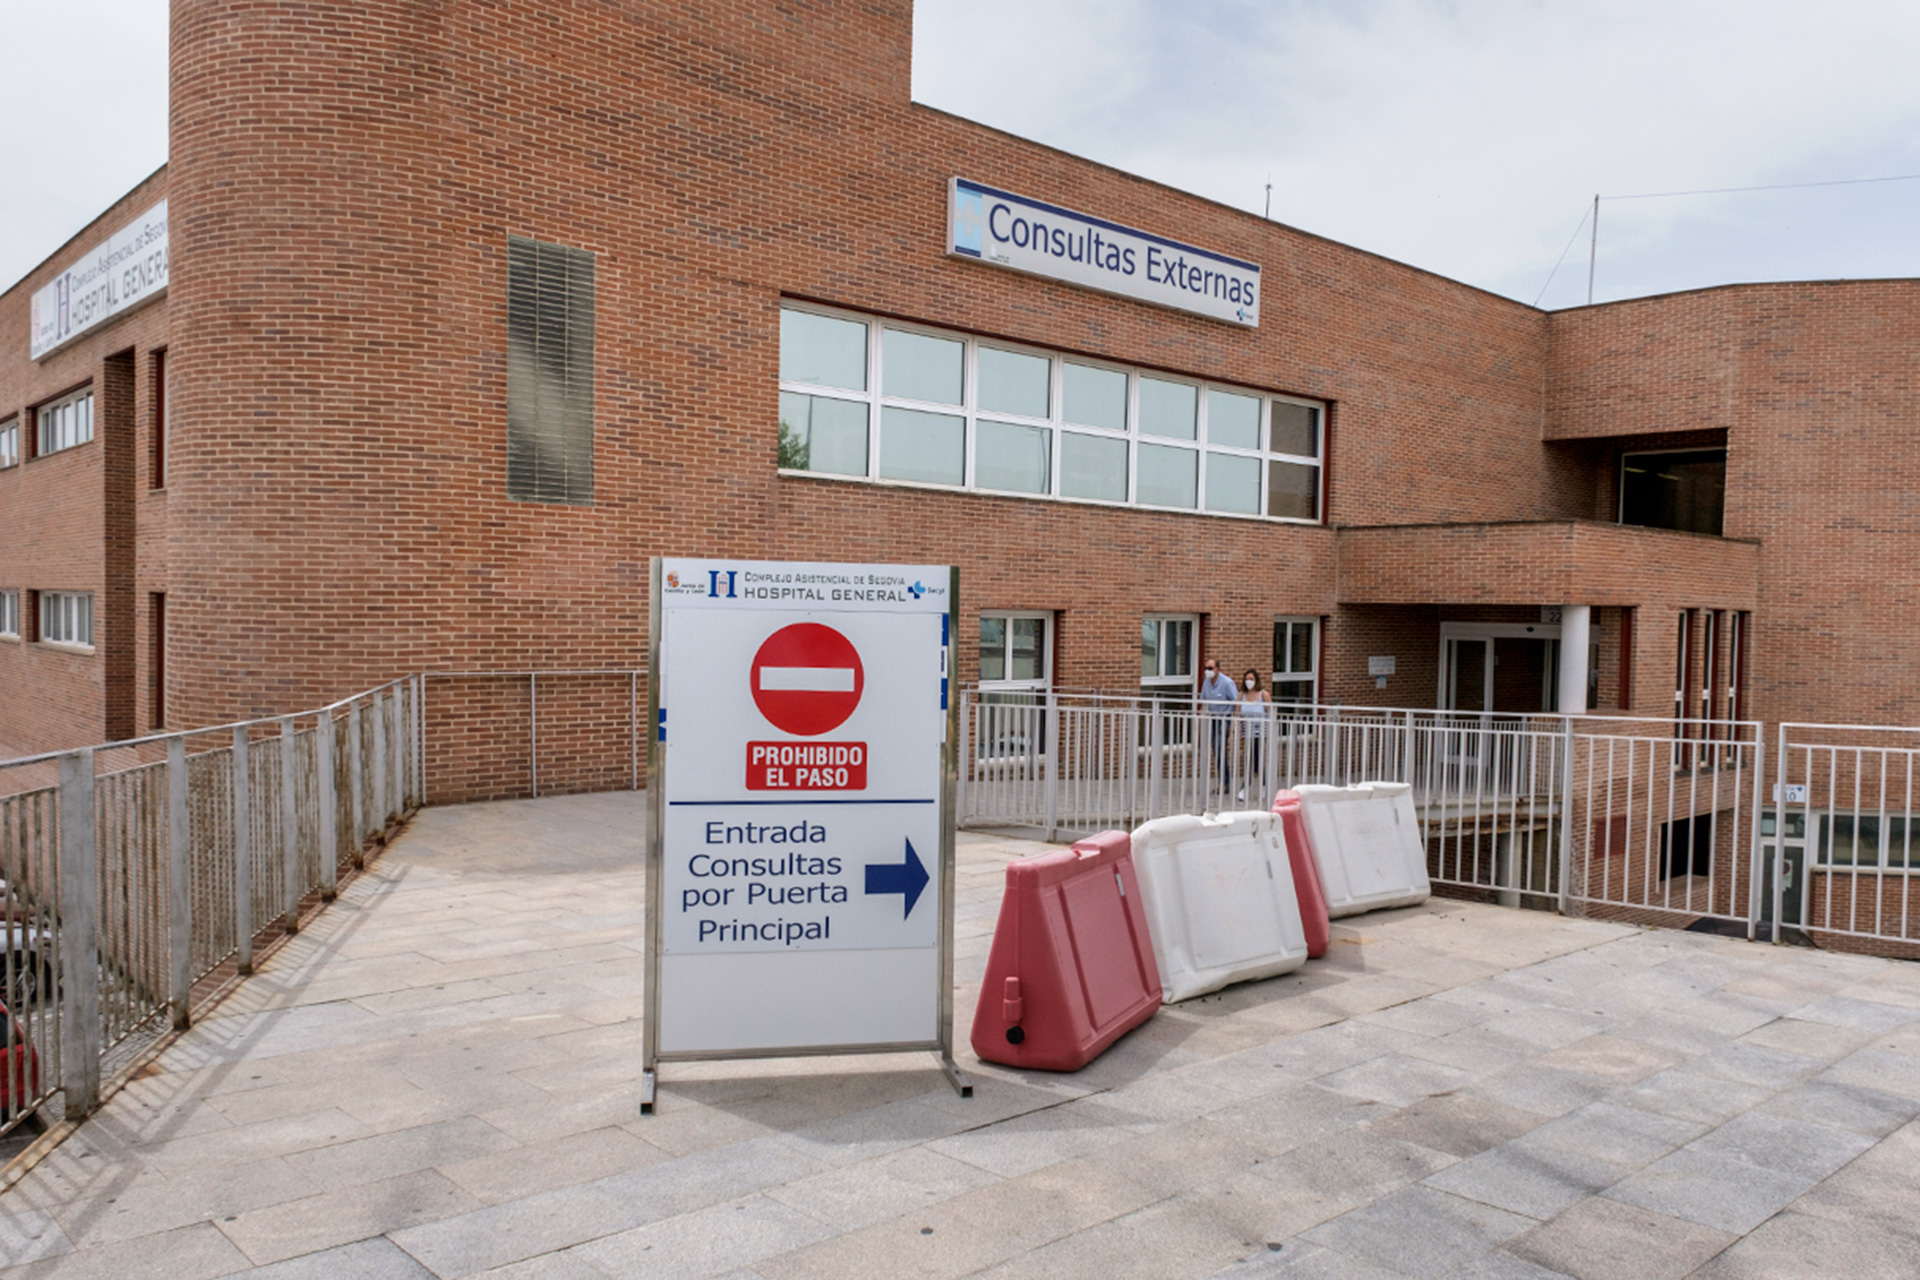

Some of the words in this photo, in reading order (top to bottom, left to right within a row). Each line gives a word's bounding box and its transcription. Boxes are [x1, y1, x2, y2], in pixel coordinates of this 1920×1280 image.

[988, 203, 1136, 277] Consultas
[1146, 245, 1255, 308] Externas
[72, 278, 119, 329] HOSPITAL
[744, 571, 792, 583] COMPLEJO
[795, 573, 851, 585] ASISTENCIAL
[853, 575, 866, 585] DE
[868, 574, 906, 586] SEGOVIA
[744, 587, 825, 601] HOSPITAL
[831, 588, 907, 602] GENERAL
[752, 746, 863, 766] PROHIBIDO
[766, 767, 790, 787] EL
[796, 767, 849, 787] PASO
[706, 820, 827, 845] Entrada
[688, 852, 843, 878] Consultas
[682, 888, 736, 913] por
[748, 882, 849, 906] Puerta
[699, 916, 830, 946] Principal
